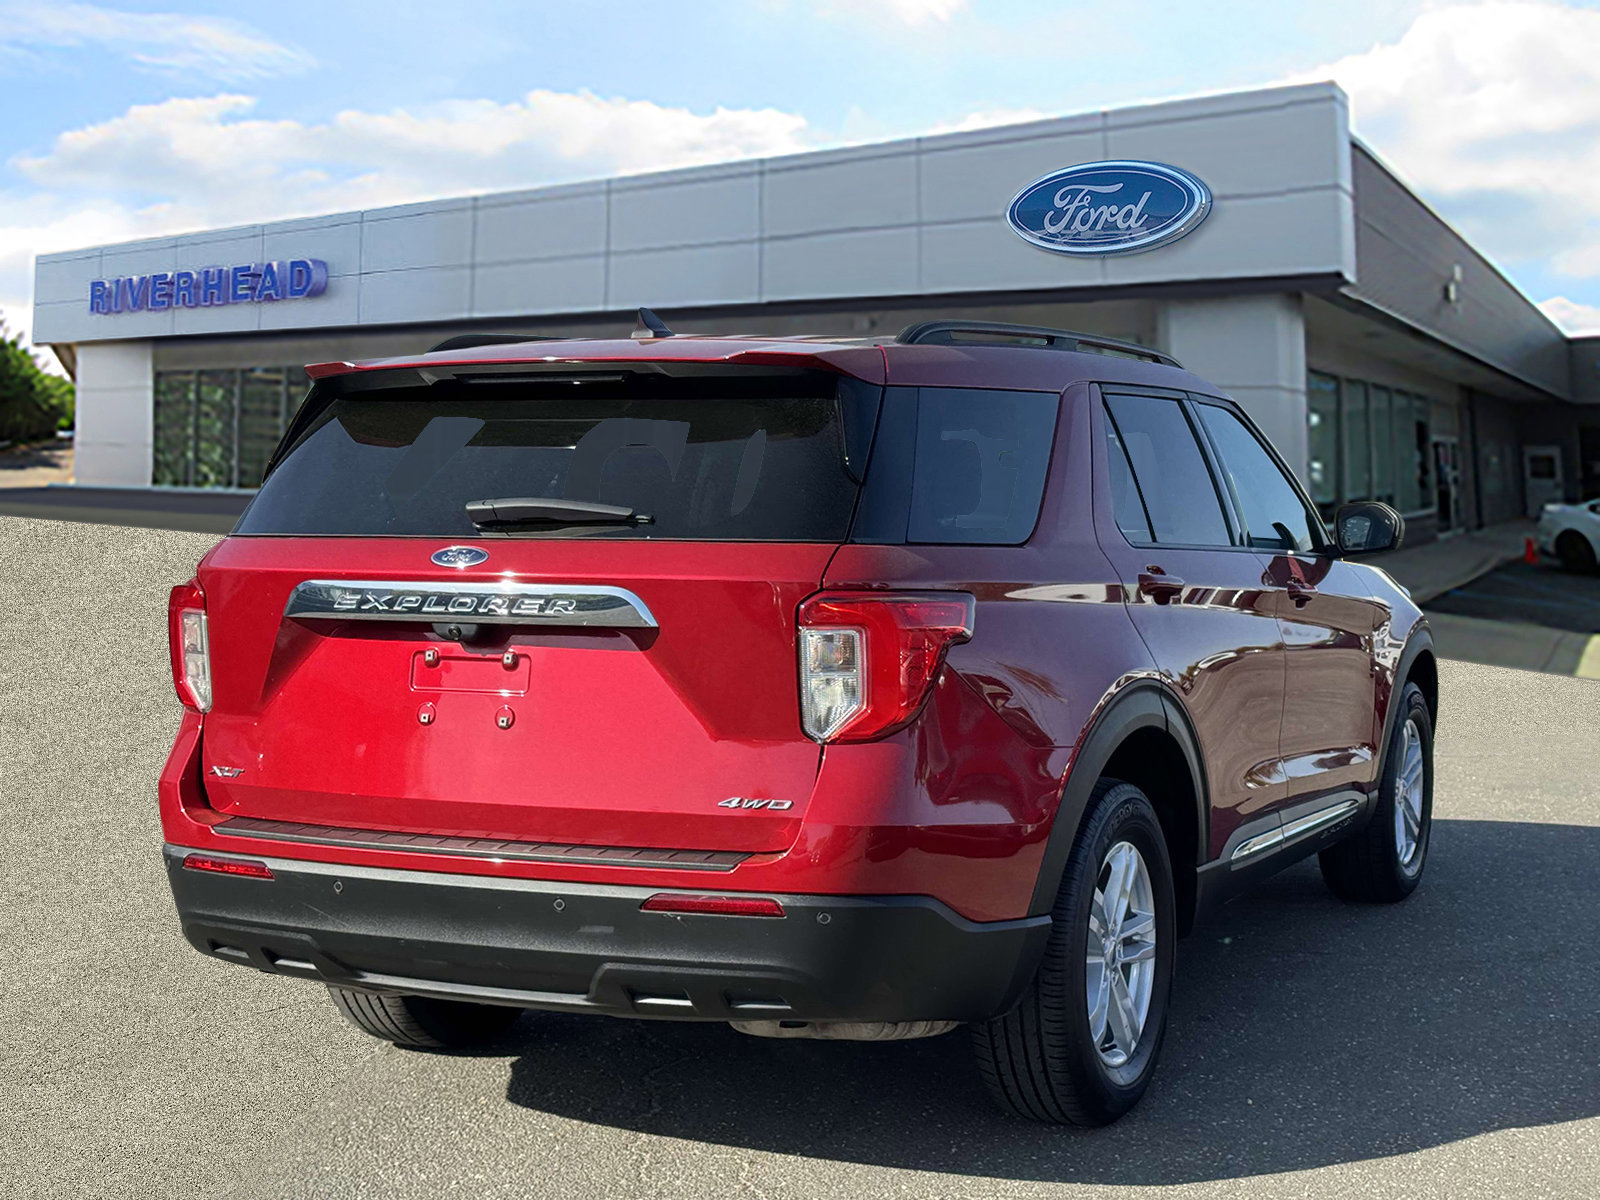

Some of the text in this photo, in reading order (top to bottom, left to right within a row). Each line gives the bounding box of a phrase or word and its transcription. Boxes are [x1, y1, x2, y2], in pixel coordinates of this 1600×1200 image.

[1044, 182, 1152, 234] Ford
[89, 258, 326, 315] RIVERHEAD
[333, 591, 577, 616] EXPLORER
[209, 765, 245, 778] XLT
[717, 796, 793, 810] 4WD
